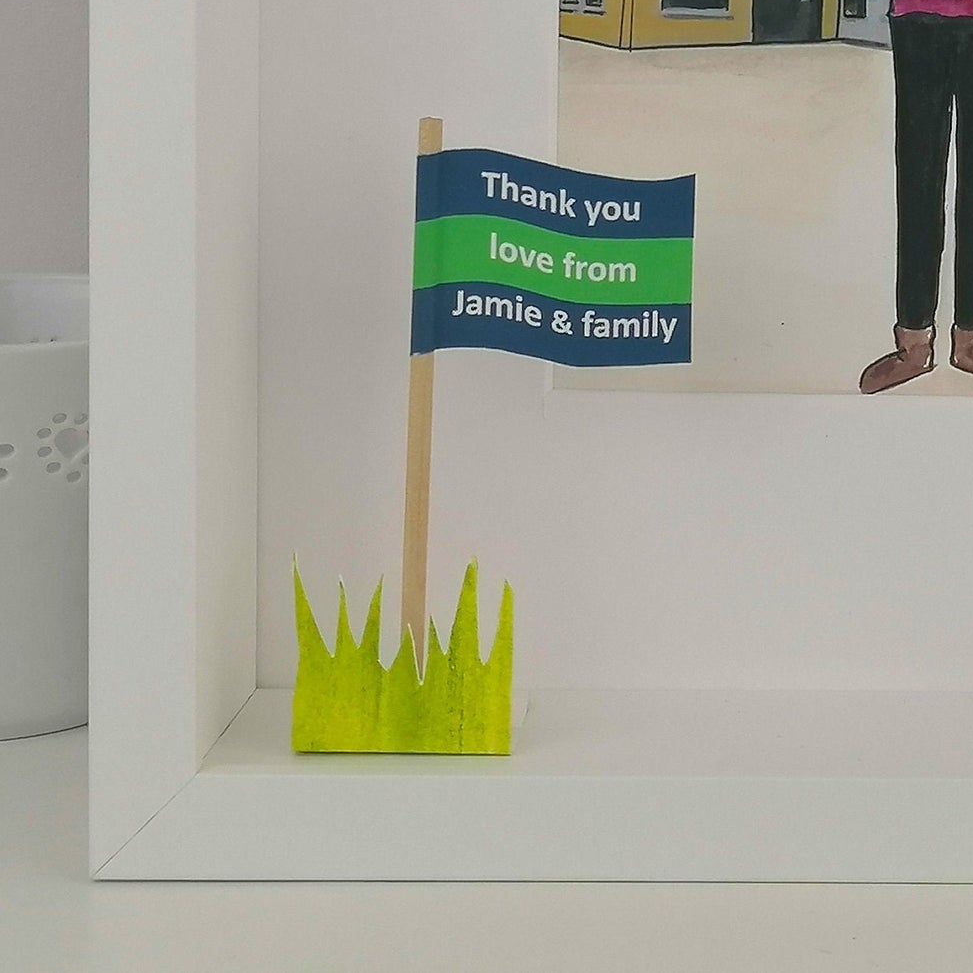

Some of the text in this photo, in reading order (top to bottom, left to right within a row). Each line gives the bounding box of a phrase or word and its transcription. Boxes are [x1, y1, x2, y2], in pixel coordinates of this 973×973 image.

[481, 171, 641, 227] Thank you
[490, 232, 637, 283] love from
[452, 290, 678, 344] Jamie & family
